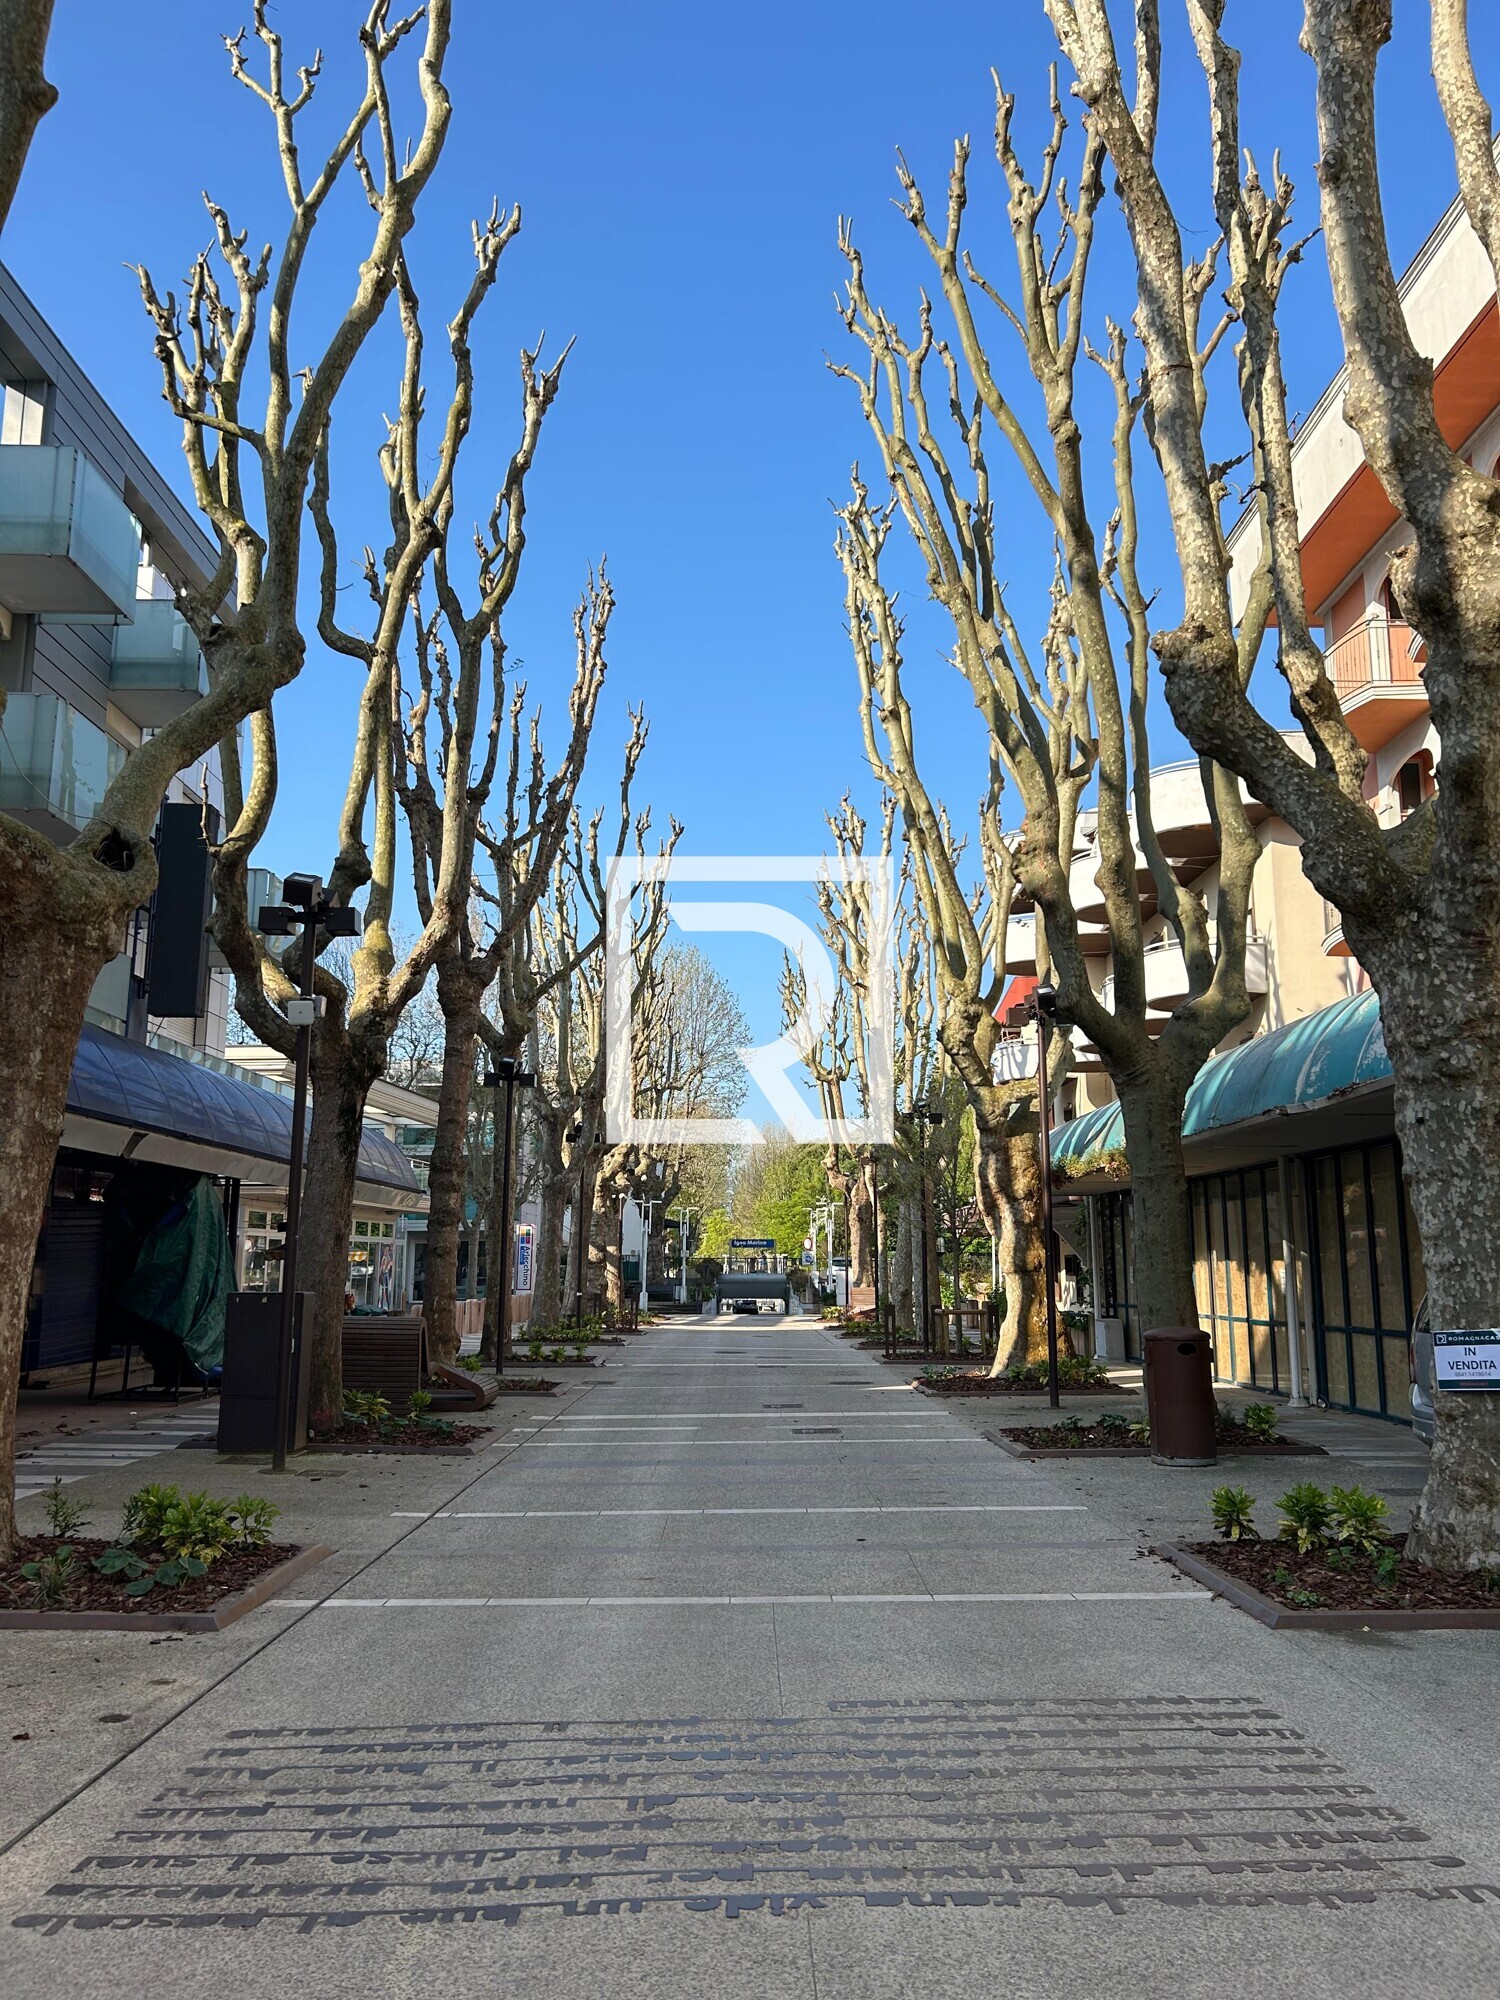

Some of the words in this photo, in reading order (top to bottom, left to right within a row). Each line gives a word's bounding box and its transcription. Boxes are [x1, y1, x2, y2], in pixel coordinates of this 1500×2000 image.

[523, 1245, 531, 1286] Arlecchino
[1464, 1347, 1476, 1356] IN
[1448, 1360, 1497, 1370] VENDITA
